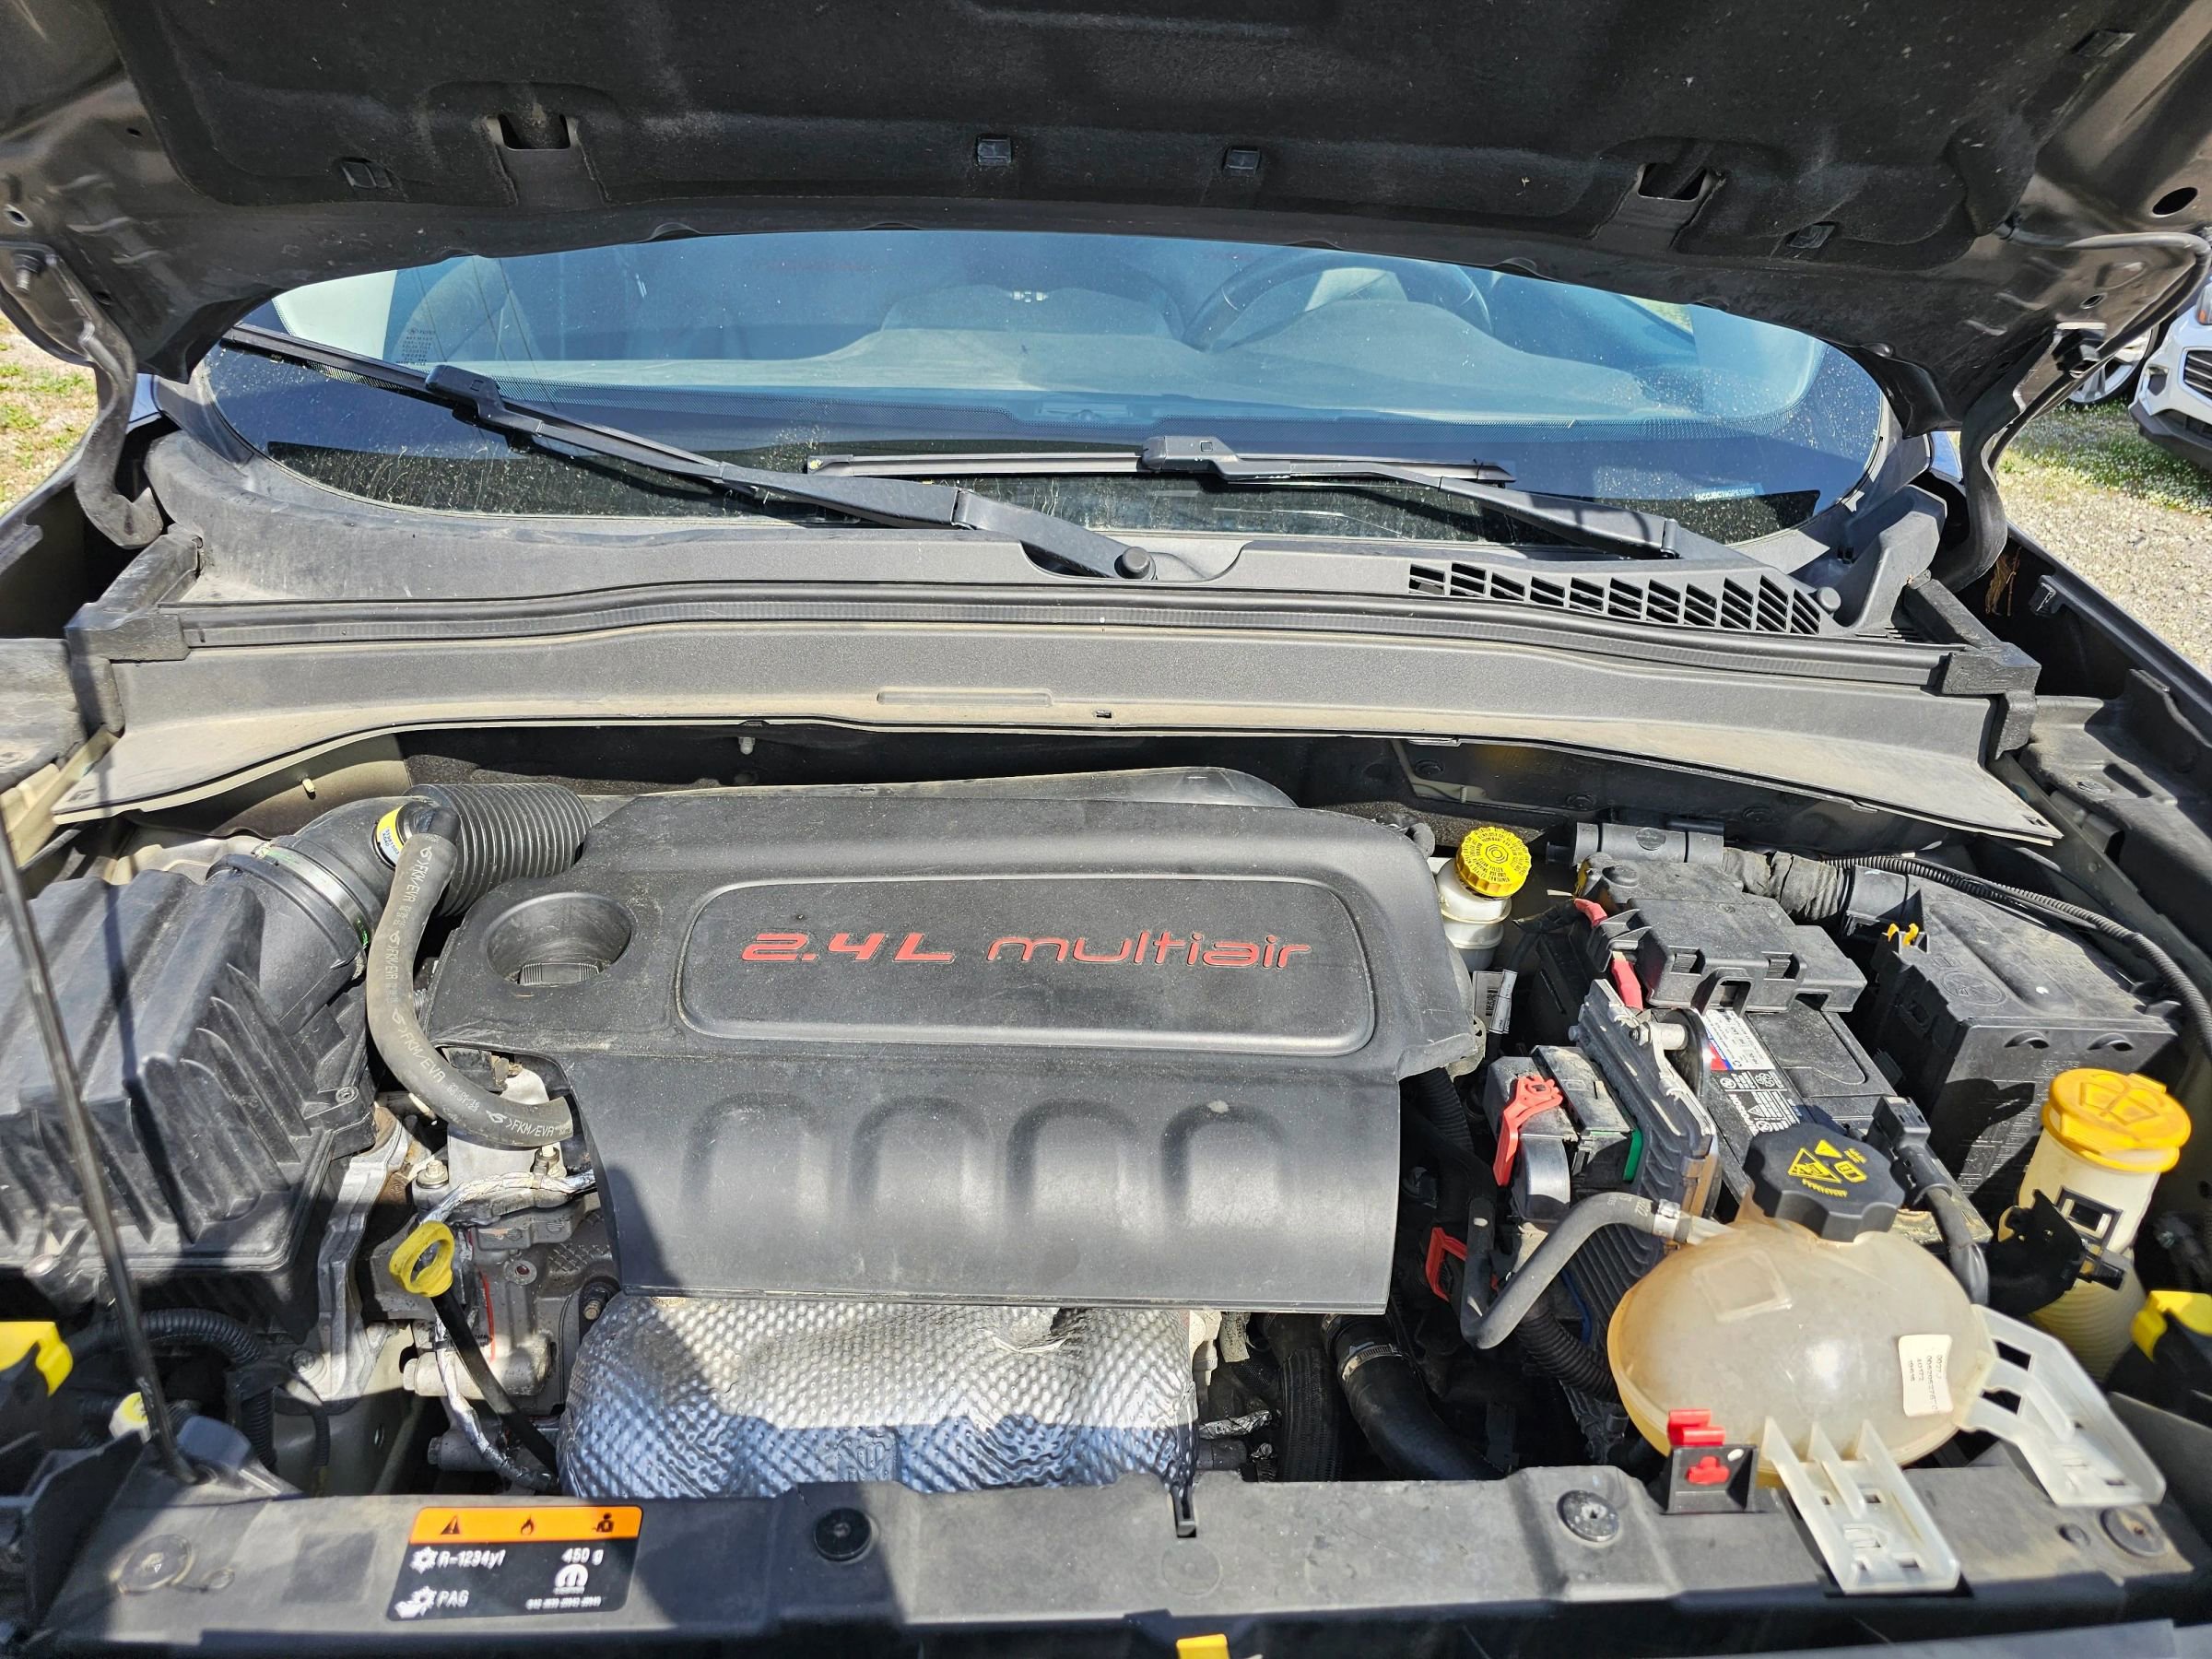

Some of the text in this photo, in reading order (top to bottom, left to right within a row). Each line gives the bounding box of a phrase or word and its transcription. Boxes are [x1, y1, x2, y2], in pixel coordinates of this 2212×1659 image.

[987, 929, 1312, 969] multiair
[561, 1547, 590, 1564] 450
[436, 1589, 469, 1607] PAG
